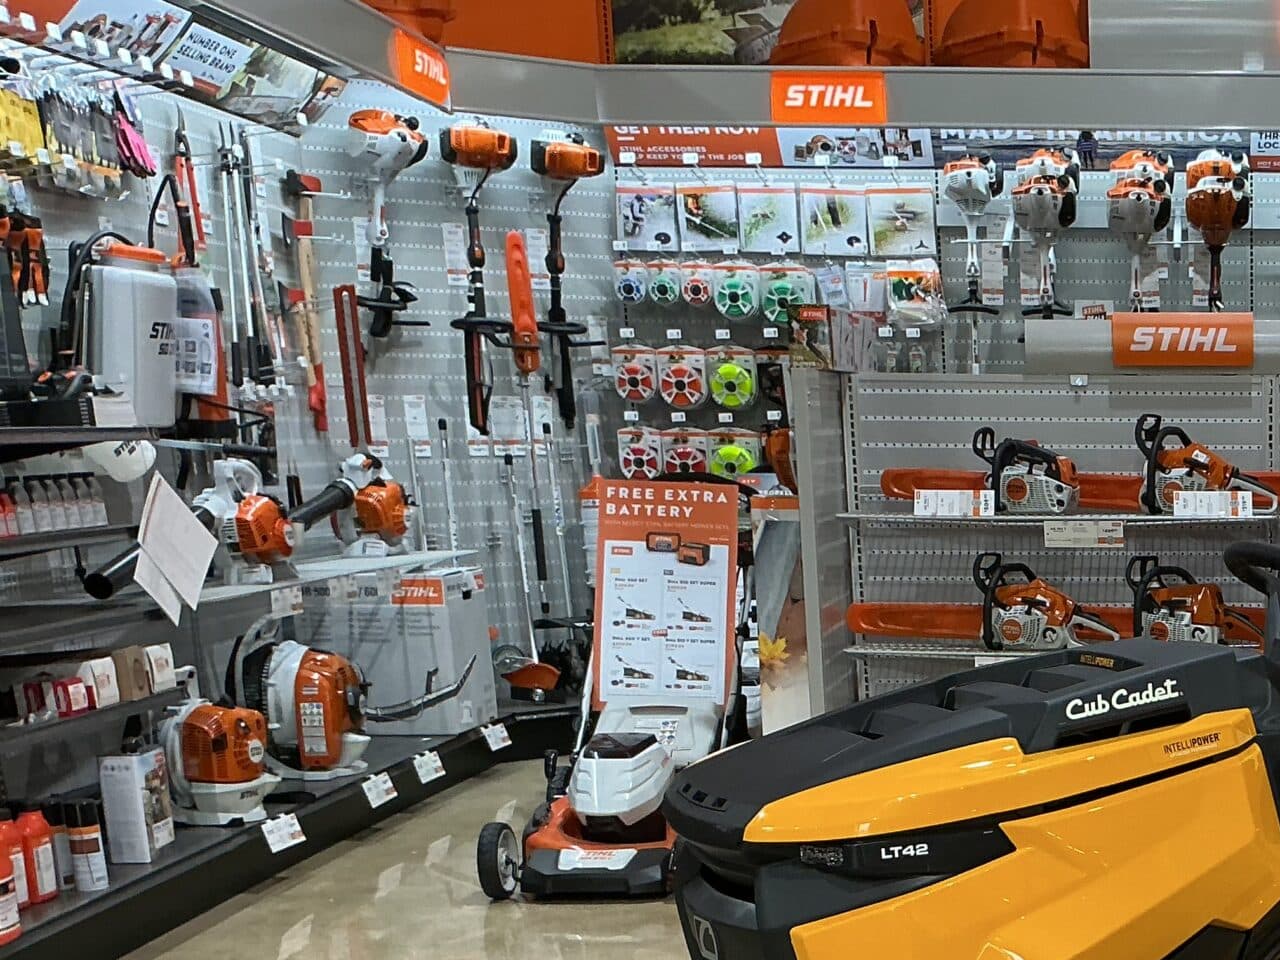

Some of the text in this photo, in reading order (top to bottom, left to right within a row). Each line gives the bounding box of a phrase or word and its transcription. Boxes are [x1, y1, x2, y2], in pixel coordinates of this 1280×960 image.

[188, 31, 238, 59] NUMBER ONE
[177, 44, 236, 74] SELLING BRAND
[414, 49, 447, 85] STIHL
[784, 84, 874, 108] STIHL
[1130, 327, 1237, 352] STIHL
[606, 486, 728, 504] FREE EXTRA
[606, 502, 694, 518] BATTERY
[393, 586, 439, 597] STIHL
[1065, 679, 1180, 720] Cub Cadet
[1162, 732, 1221, 754] INTELLIPOWER
[880, 843, 929, 860] LT42
